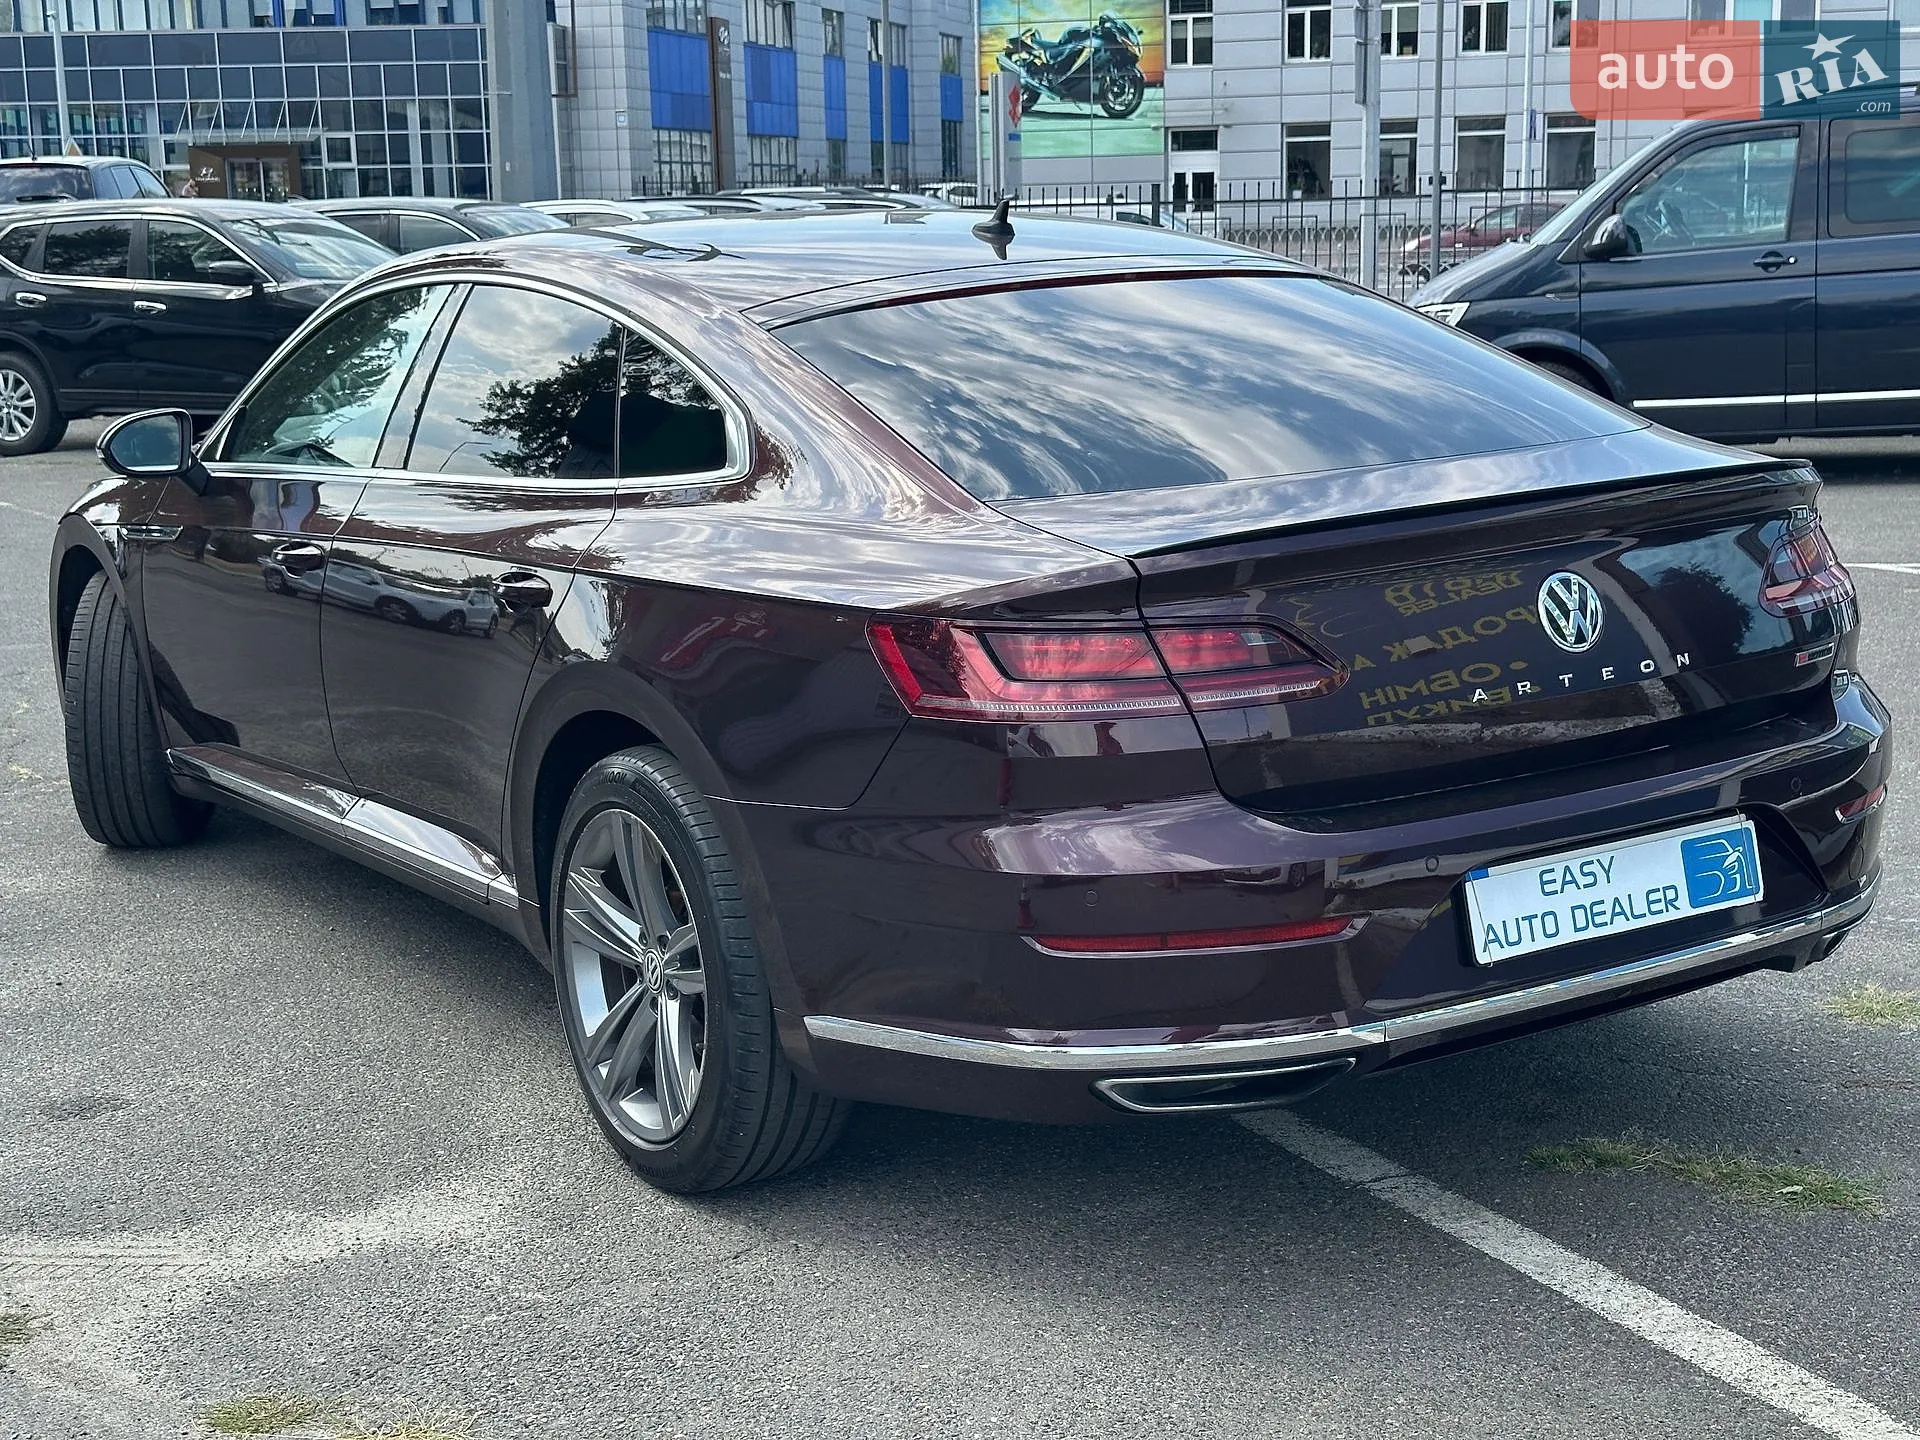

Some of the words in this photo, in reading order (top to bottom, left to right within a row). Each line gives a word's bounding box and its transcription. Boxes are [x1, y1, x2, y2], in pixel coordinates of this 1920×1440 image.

[1472, 652, 1690, 703] ARTEON
[1539, 856, 1616, 896] EASY
[1482, 910, 1560, 953] AUTO
[1570, 884, 1681, 934] DEALER
